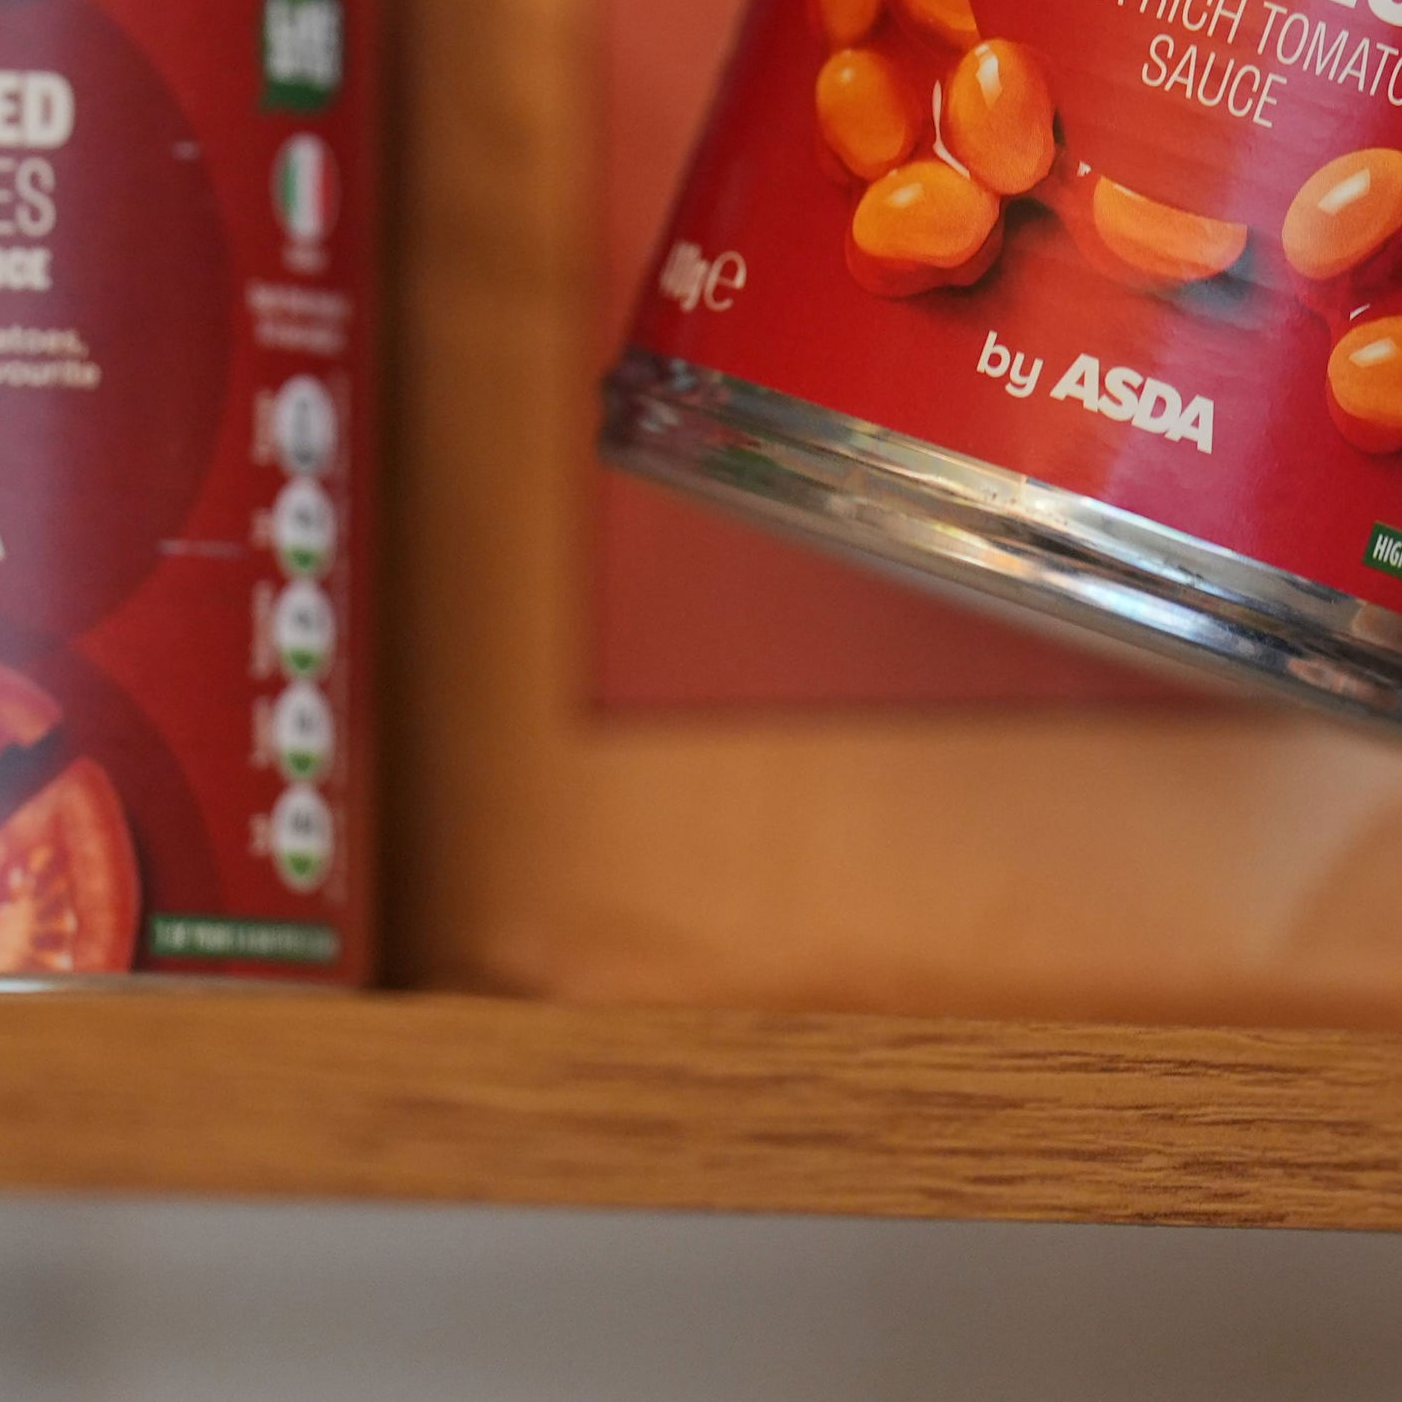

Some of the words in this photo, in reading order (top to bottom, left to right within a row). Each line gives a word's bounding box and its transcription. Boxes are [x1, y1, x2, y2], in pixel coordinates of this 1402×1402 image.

[1141, 35, 1290, 129] SAUCE
[977, 330, 1043, 398] by
[1050, 353, 1214, 454] ASDA
